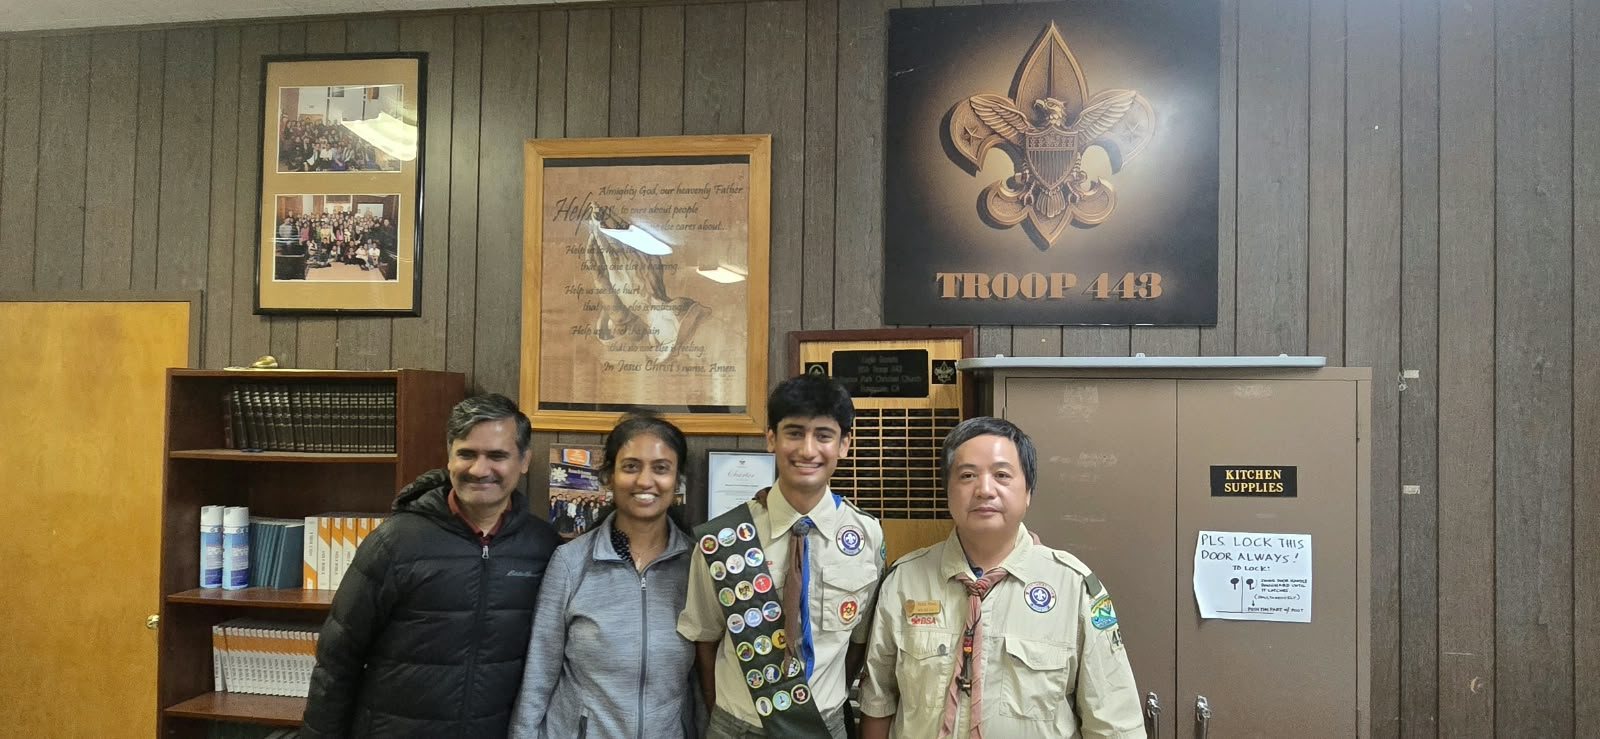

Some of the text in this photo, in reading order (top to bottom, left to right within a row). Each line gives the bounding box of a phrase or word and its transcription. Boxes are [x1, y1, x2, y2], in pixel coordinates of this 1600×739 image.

[599, 182, 743, 201] Almighty God, our heavenly Father
[552, 191, 594, 236] Help
[648, 204, 672, 214] about
[671, 202, 699, 219] people
[565, 244, 585, 259] Help
[564, 283, 585, 300] Help
[622, 282, 641, 294] hurt
[935, 271, 1164, 299] TROOP 443
[582, 299, 600, 311] that
[572, 324, 592, 340] Help
[602, 361, 615, 372] In
[617, 360, 642, 373] Jesus
[1225, 469, 1282, 480] KITCHEN
[1224, 482, 1284, 493] SUPPLIES
[1201, 533, 1304, 549] PLS LOCK THIS
[1201, 549, 1233, 561] DOOR
[920, 616, 936, 625] BSA
